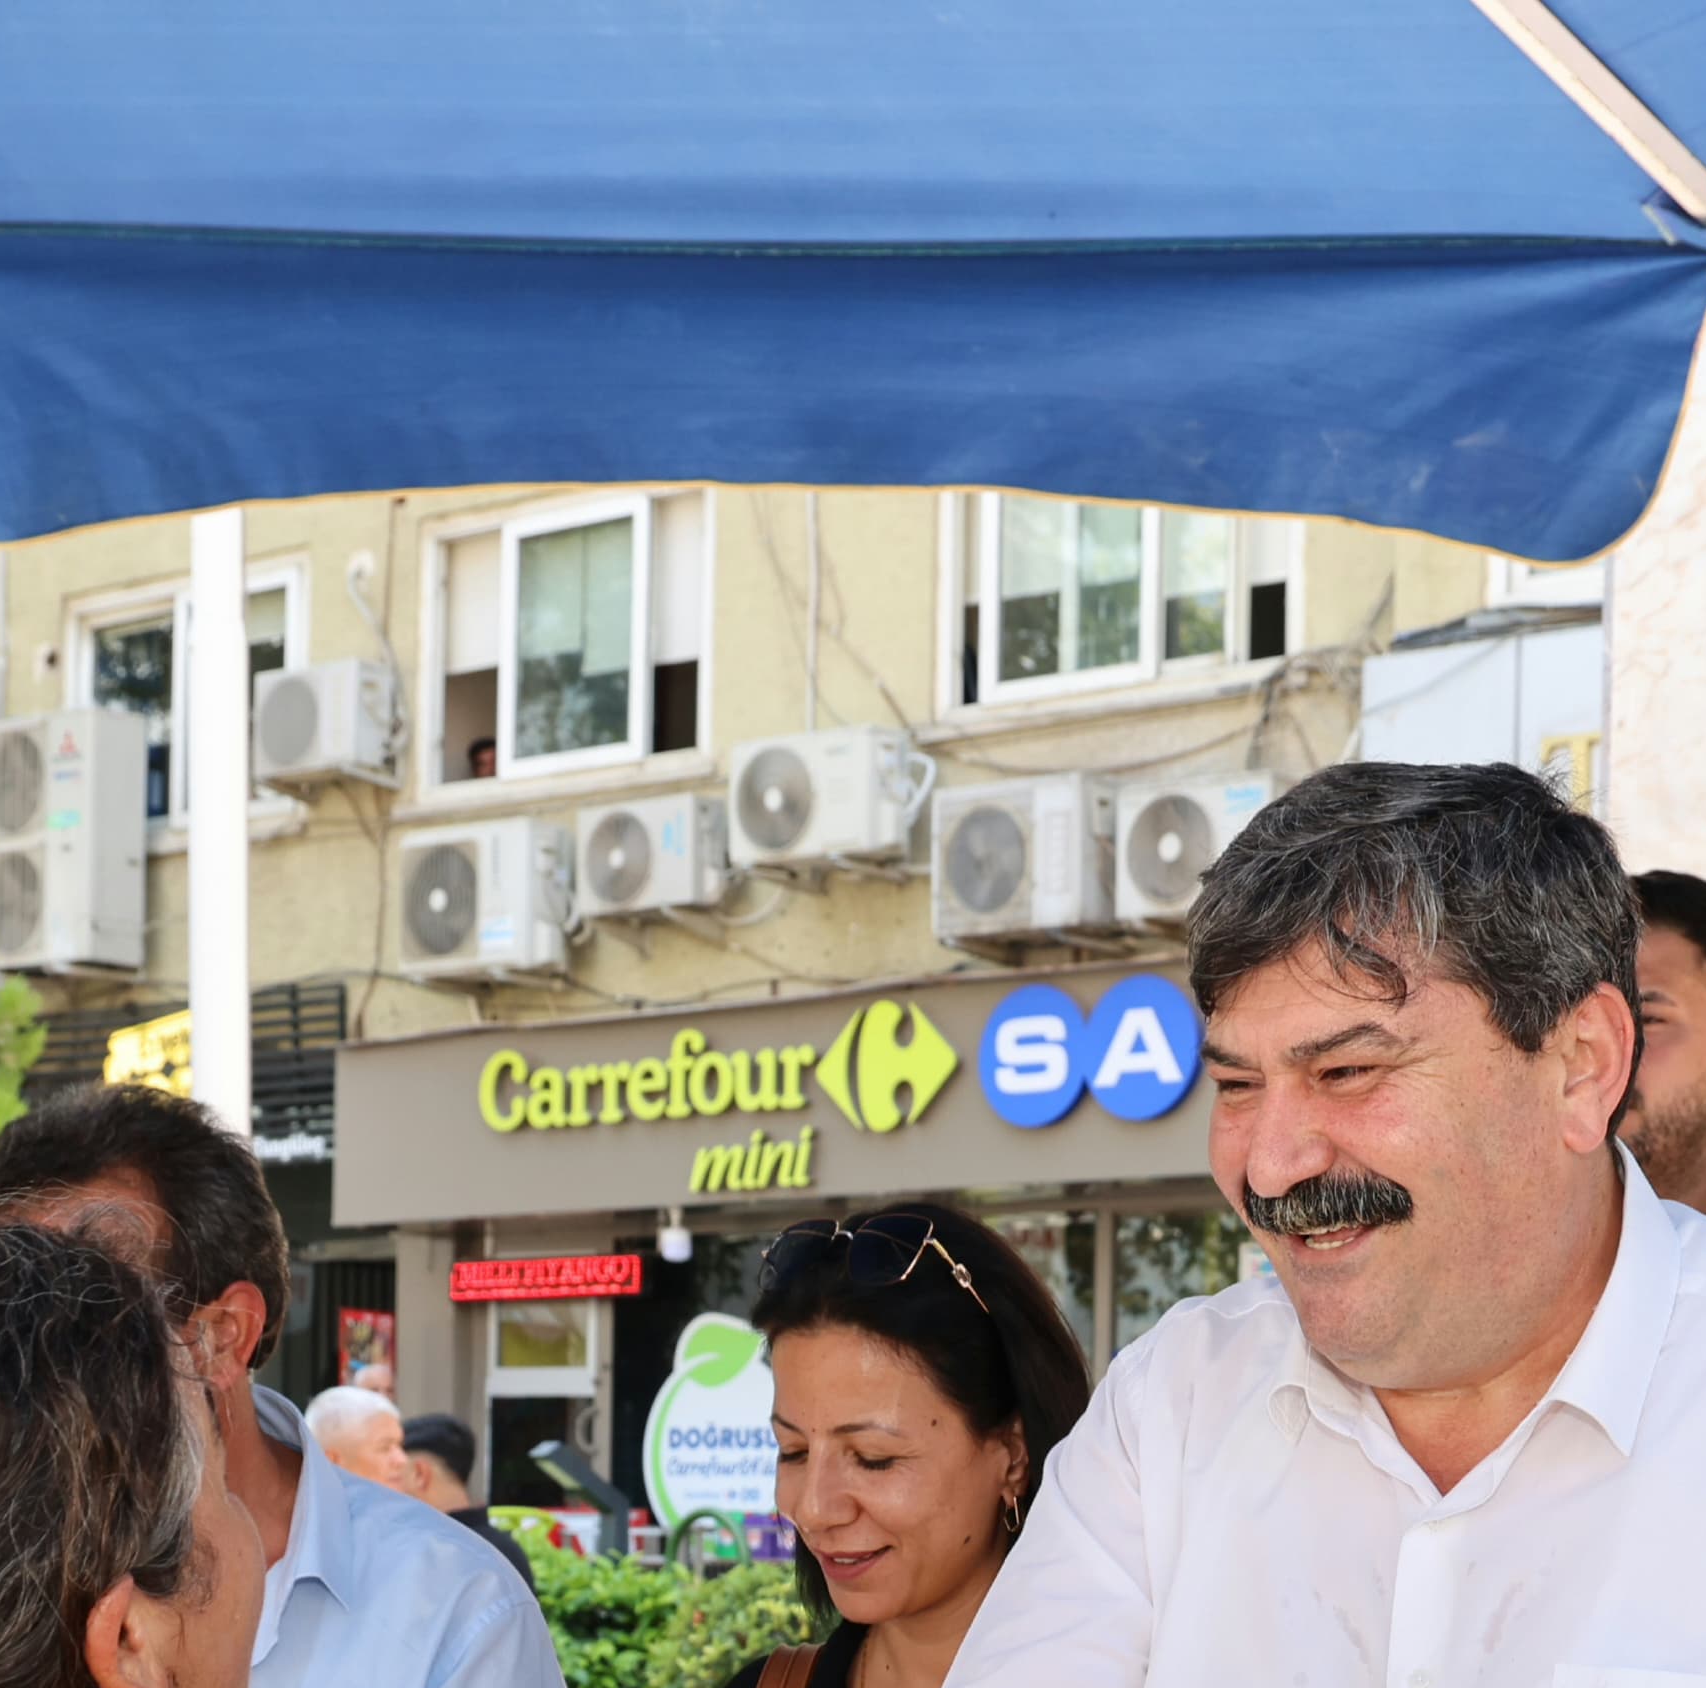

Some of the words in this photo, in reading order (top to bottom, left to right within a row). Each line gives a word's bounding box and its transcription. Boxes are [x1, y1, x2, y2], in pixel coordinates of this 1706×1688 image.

[479, 1028, 816, 1133] Carrefour
[994, 1007, 1184, 1095] SA
[689, 1124, 815, 1193] mini
